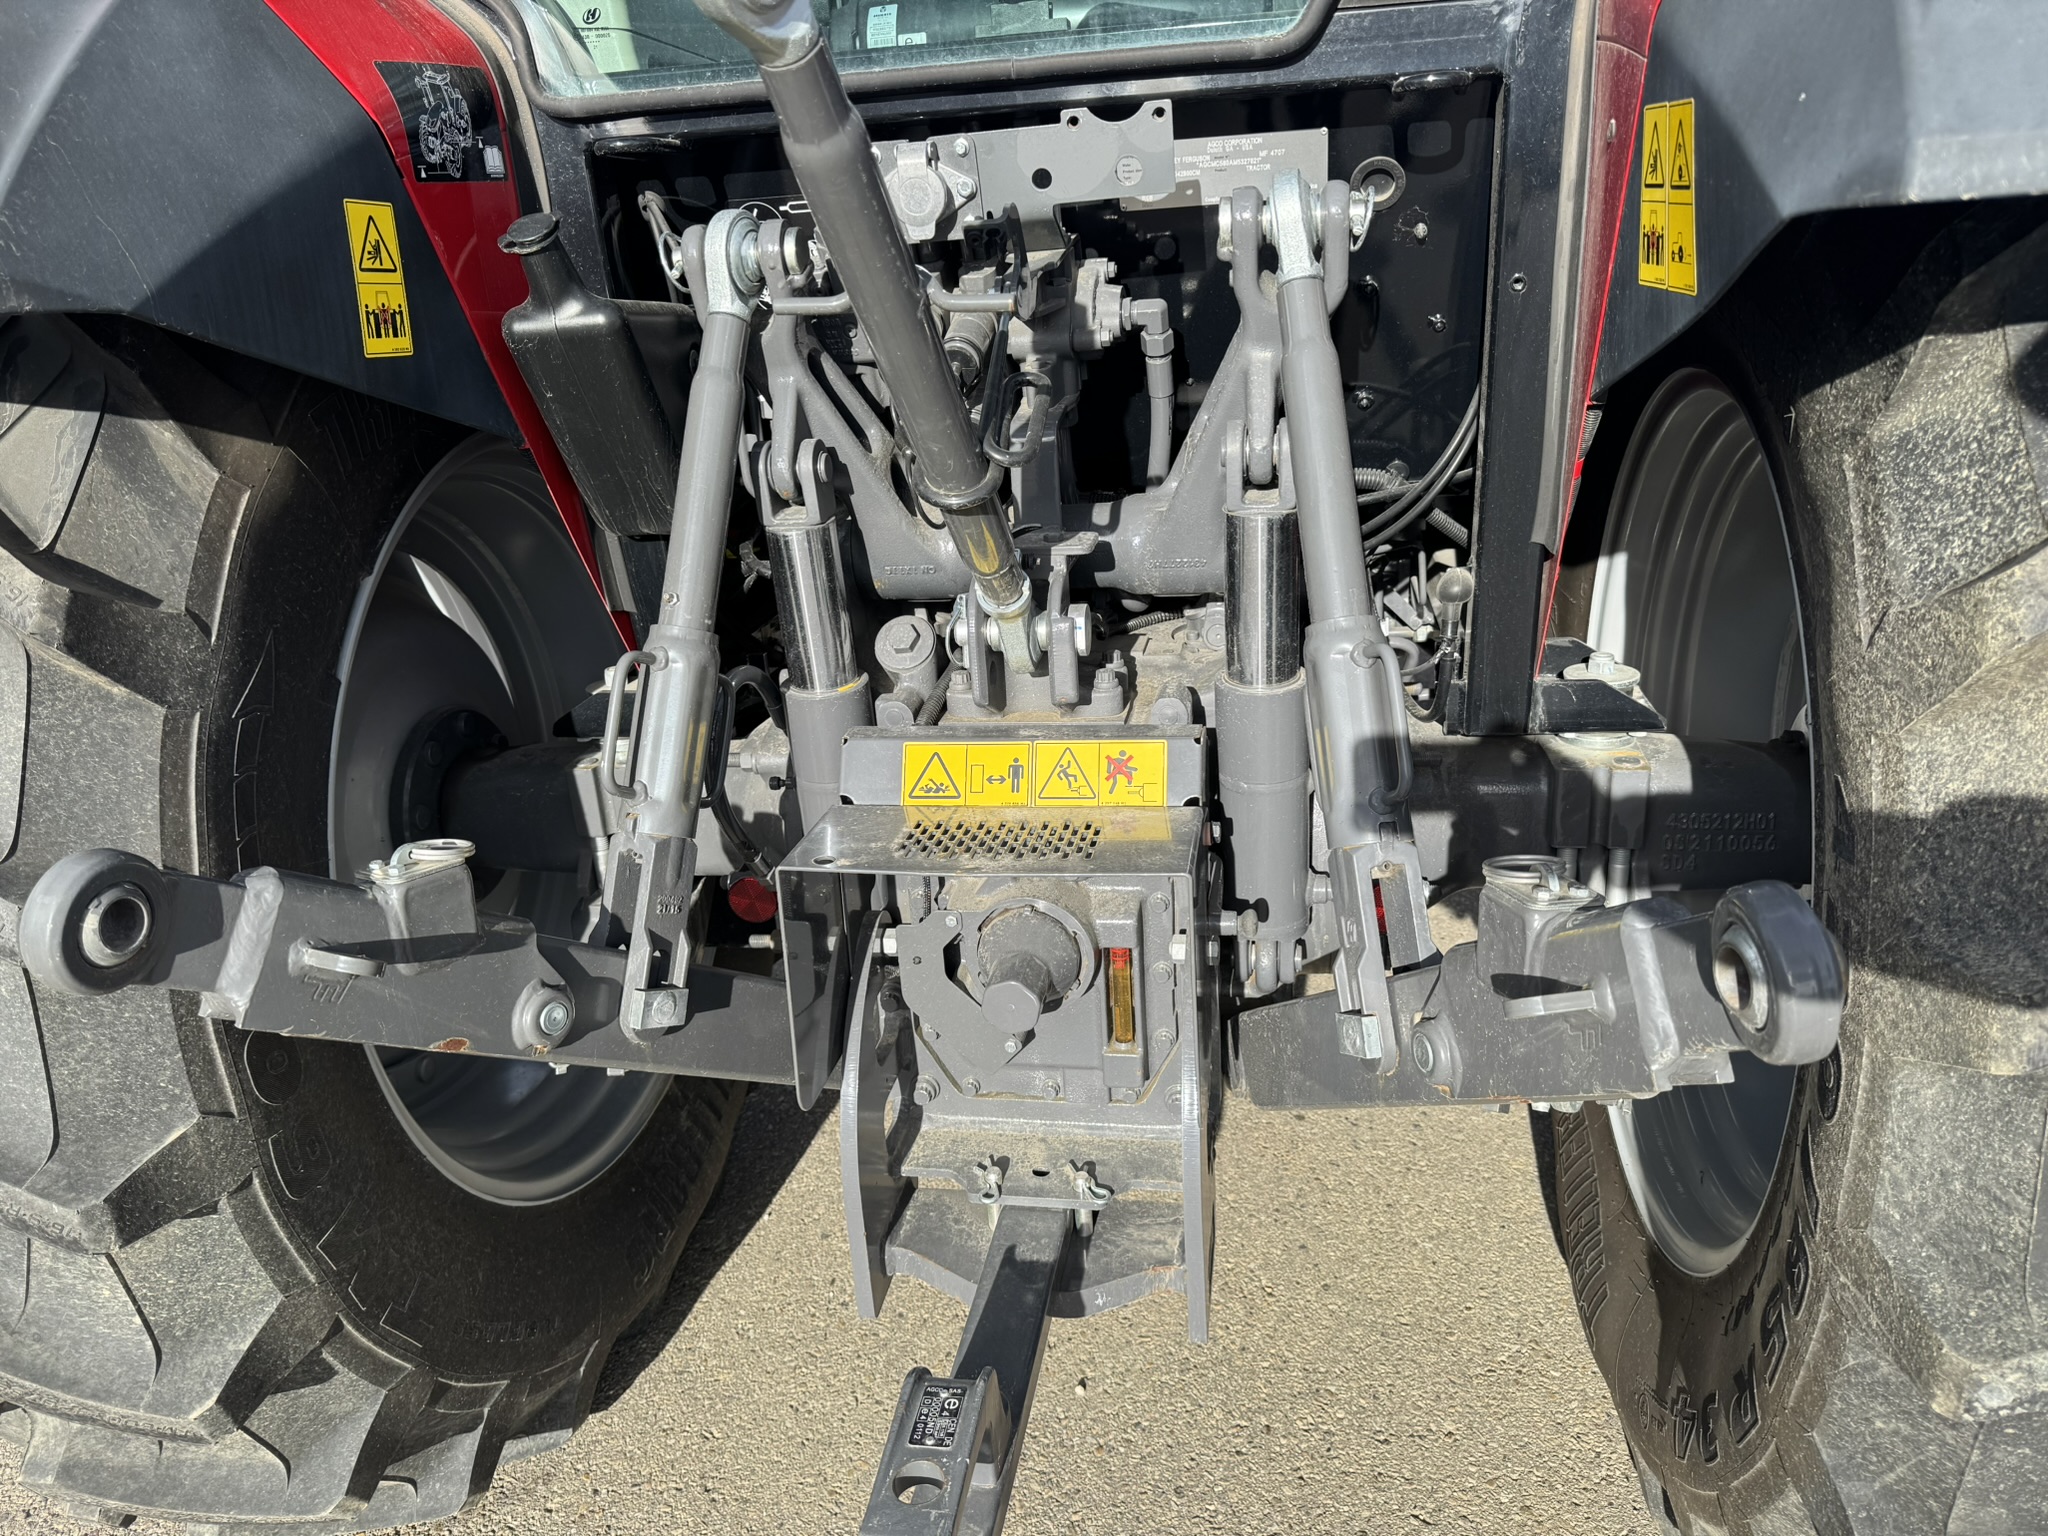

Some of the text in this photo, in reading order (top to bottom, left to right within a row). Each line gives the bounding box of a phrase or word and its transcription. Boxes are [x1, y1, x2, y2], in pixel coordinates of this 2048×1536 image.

[1224, 137, 1263, 147] CORPORATION
[1182, 155, 1210, 164] FERGUSON
[1246, 163, 1271, 172] TRACTOR
[913, 1423, 925, 1440] 0112
[943, 1436, 953, 1446] DE
